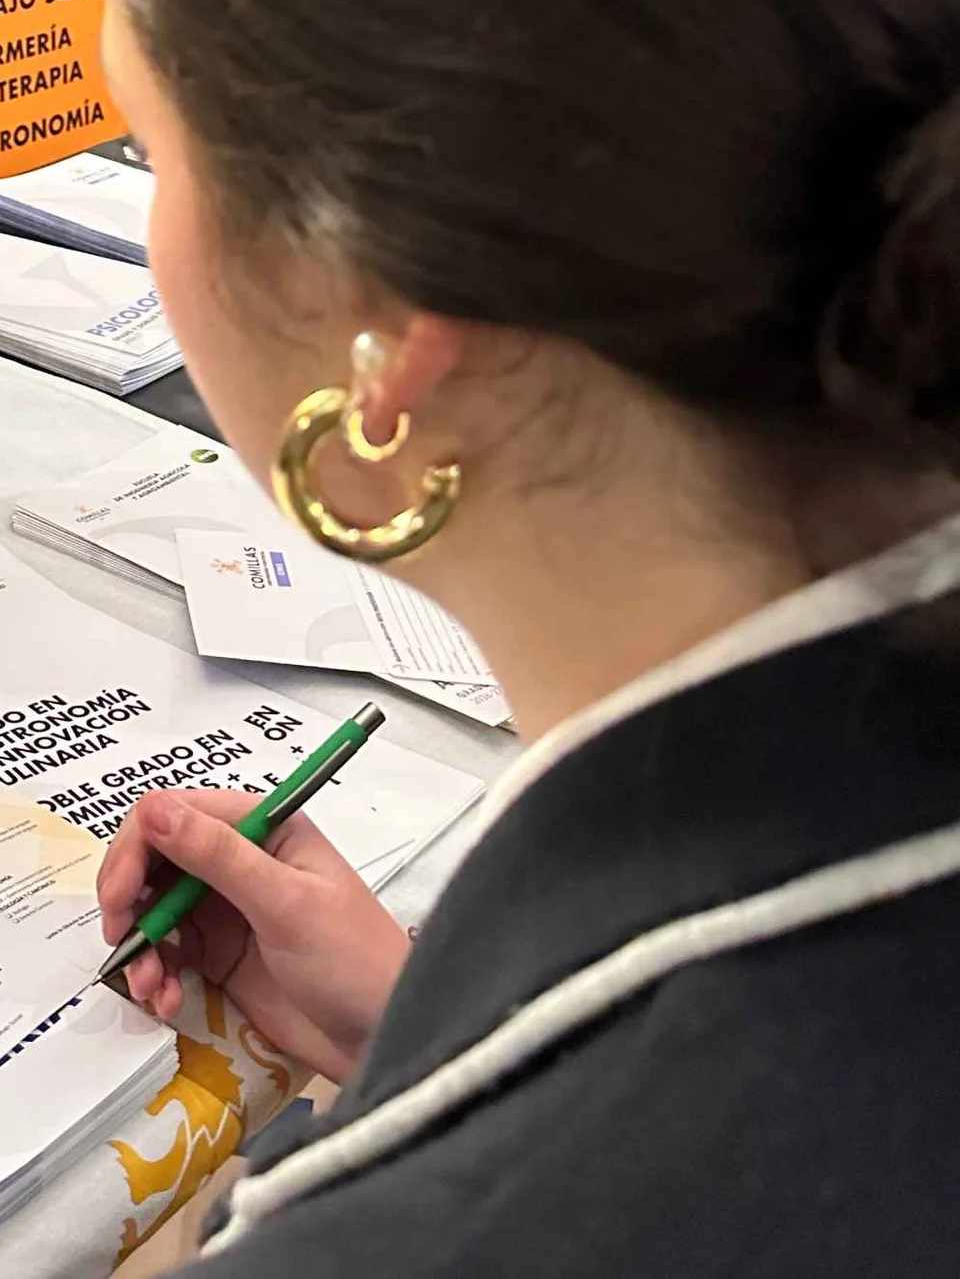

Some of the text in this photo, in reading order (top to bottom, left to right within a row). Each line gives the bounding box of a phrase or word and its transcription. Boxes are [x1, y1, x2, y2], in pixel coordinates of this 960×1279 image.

[243, 546, 266, 589] COMILLAS
[34, 693, 67, 718] EN
[244, 705, 281, 730] EN
[102, 746, 193, 788] GRADO
[194, 729, 234, 752] EN
[63, 743, 253, 825] MINISTRACIÓN
